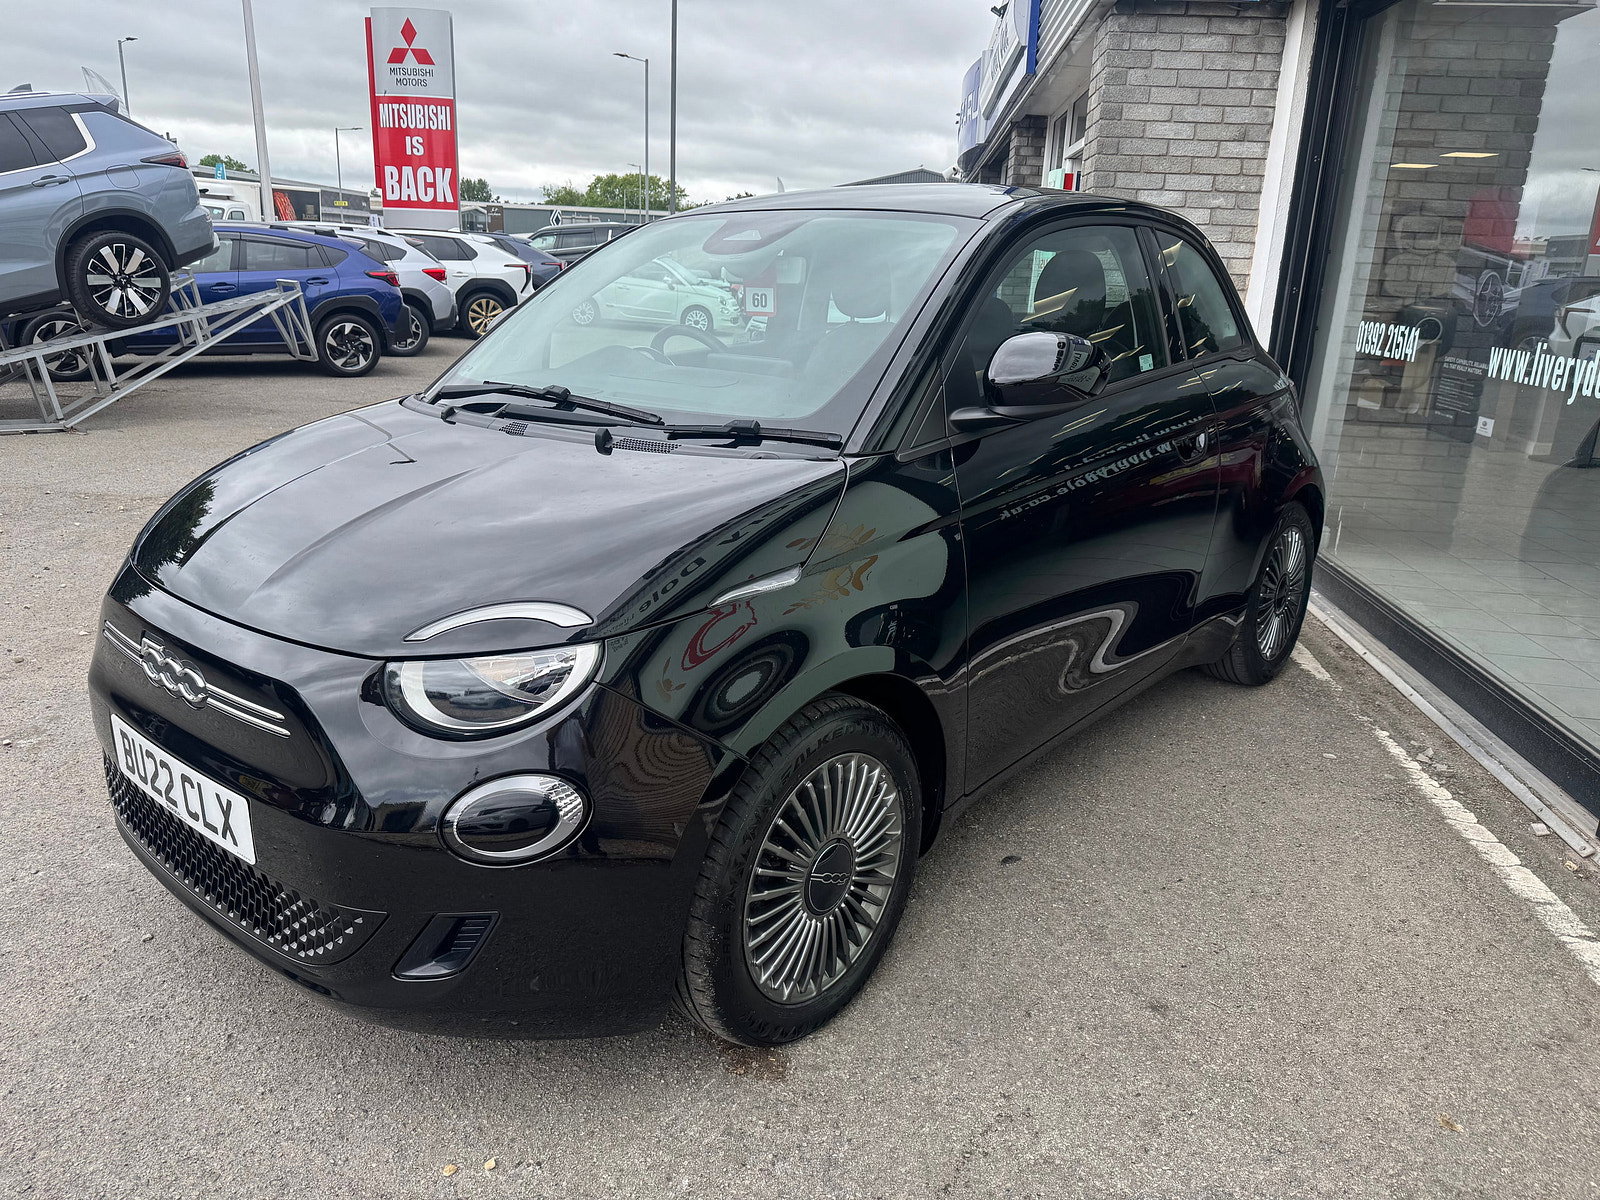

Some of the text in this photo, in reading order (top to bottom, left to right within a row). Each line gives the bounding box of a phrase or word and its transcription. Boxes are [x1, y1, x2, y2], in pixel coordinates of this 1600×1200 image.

[389, 67, 434, 77] MITSUBISHI
[395, 77, 428, 87] MOTORS
[379, 103, 451, 131] MITSUBISHI
[405, 136, 425, 156] IS
[384, 165, 454, 203] BACK
[752, 292, 768, 309] 60
[1355, 320, 1421, 363] 01392 215141
[140, 636, 209, 707] 500
[119, 728, 239, 848] BU22 CLX
